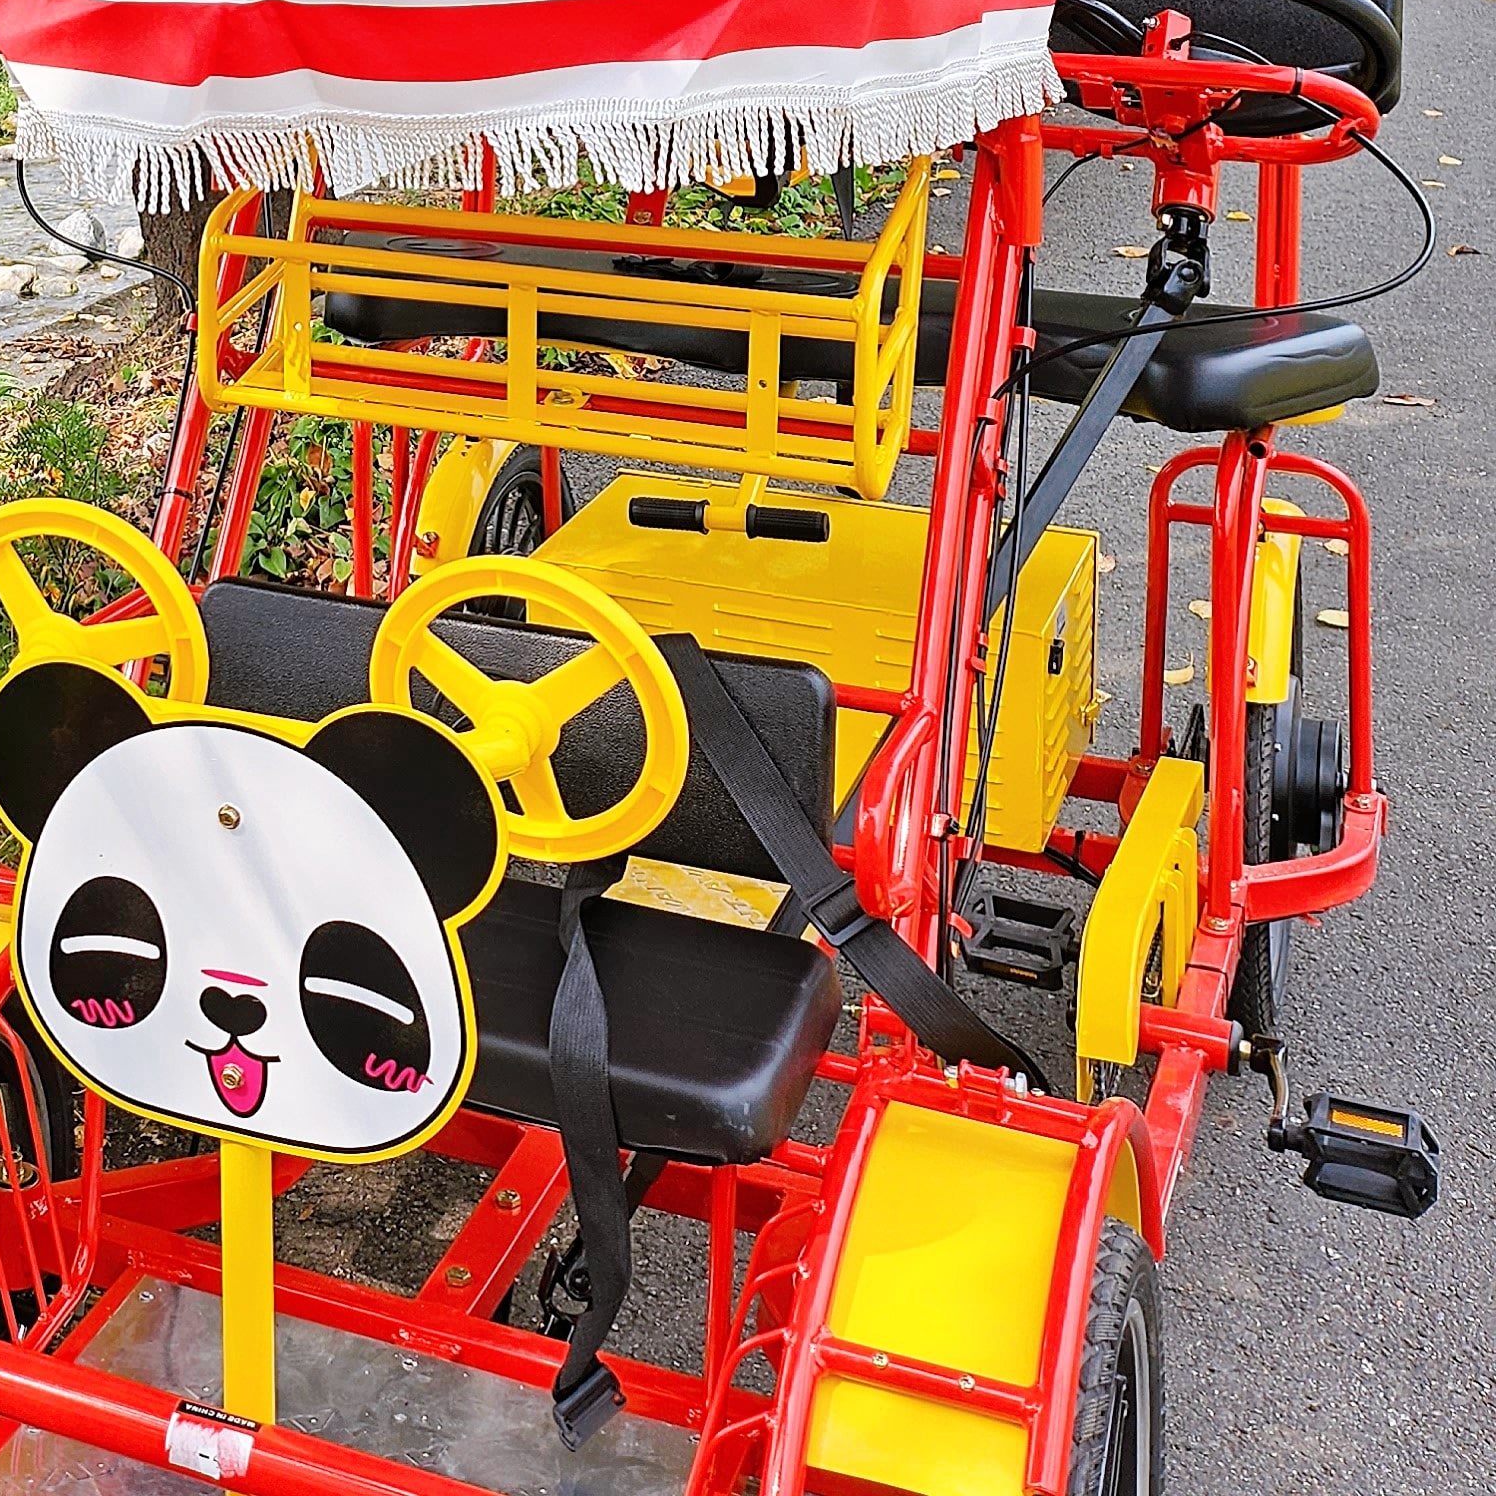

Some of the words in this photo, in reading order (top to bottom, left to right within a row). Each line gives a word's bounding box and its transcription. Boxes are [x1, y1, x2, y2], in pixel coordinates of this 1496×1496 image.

[185, 1403, 215, 1416] CHINA
[216, 1411, 227, 1419] IN
[227, 1415, 256, 1428] MADE
